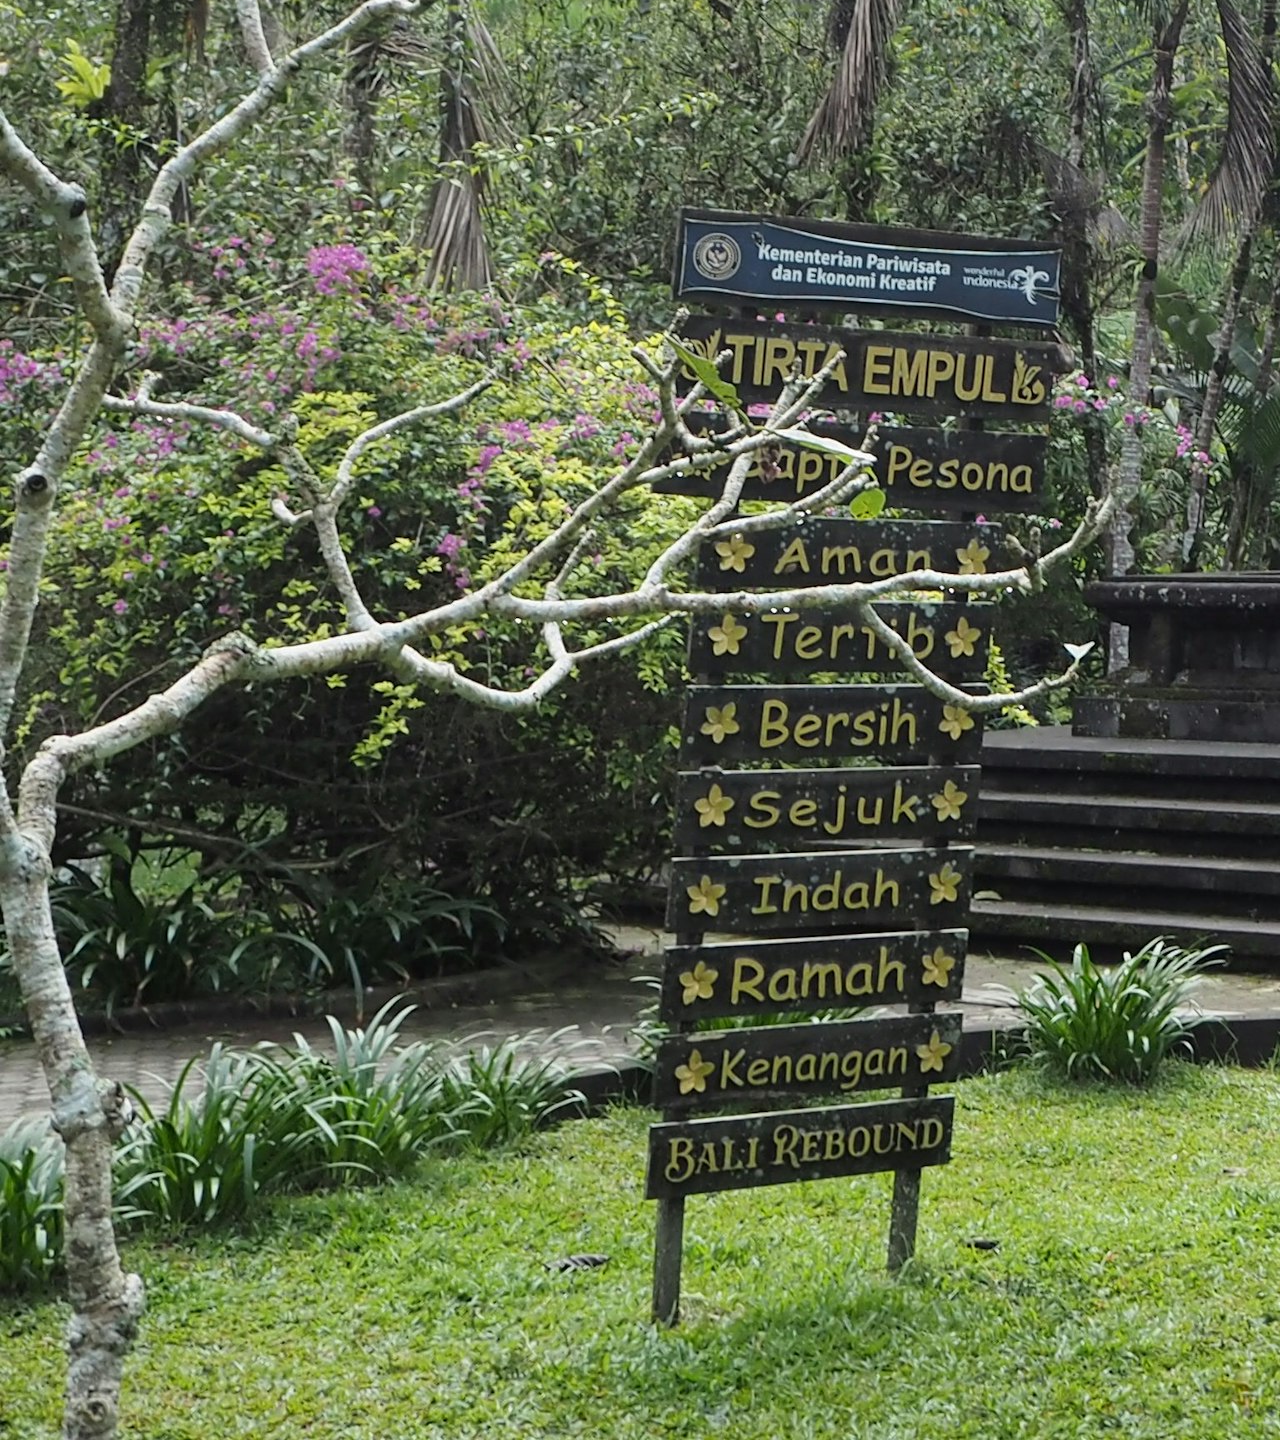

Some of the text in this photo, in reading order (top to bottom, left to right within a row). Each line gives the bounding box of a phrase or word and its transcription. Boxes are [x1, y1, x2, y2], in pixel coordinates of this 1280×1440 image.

[758, 244, 862, 268] Kementerian
[866, 252, 951, 275] Pariwisata
[771, 264, 937, 292] dan Ekonomi Kreatif
[963, 266, 1005, 277] wonderful
[725, 334, 1006, 403] TIRTA EMPUL
[887, 445, 1032, 493] Pesona
[774, 537, 931, 576] Aman
[760, 697, 916, 749] Bersih
[743, 780, 919, 834] Sejuk
[751, 869, 899, 915] Indah
[731, 946, 904, 1005] Ramah
[720, 1046, 907, 1091] Kenangan
[665, 1118, 944, 1182] BALI REBOUND
